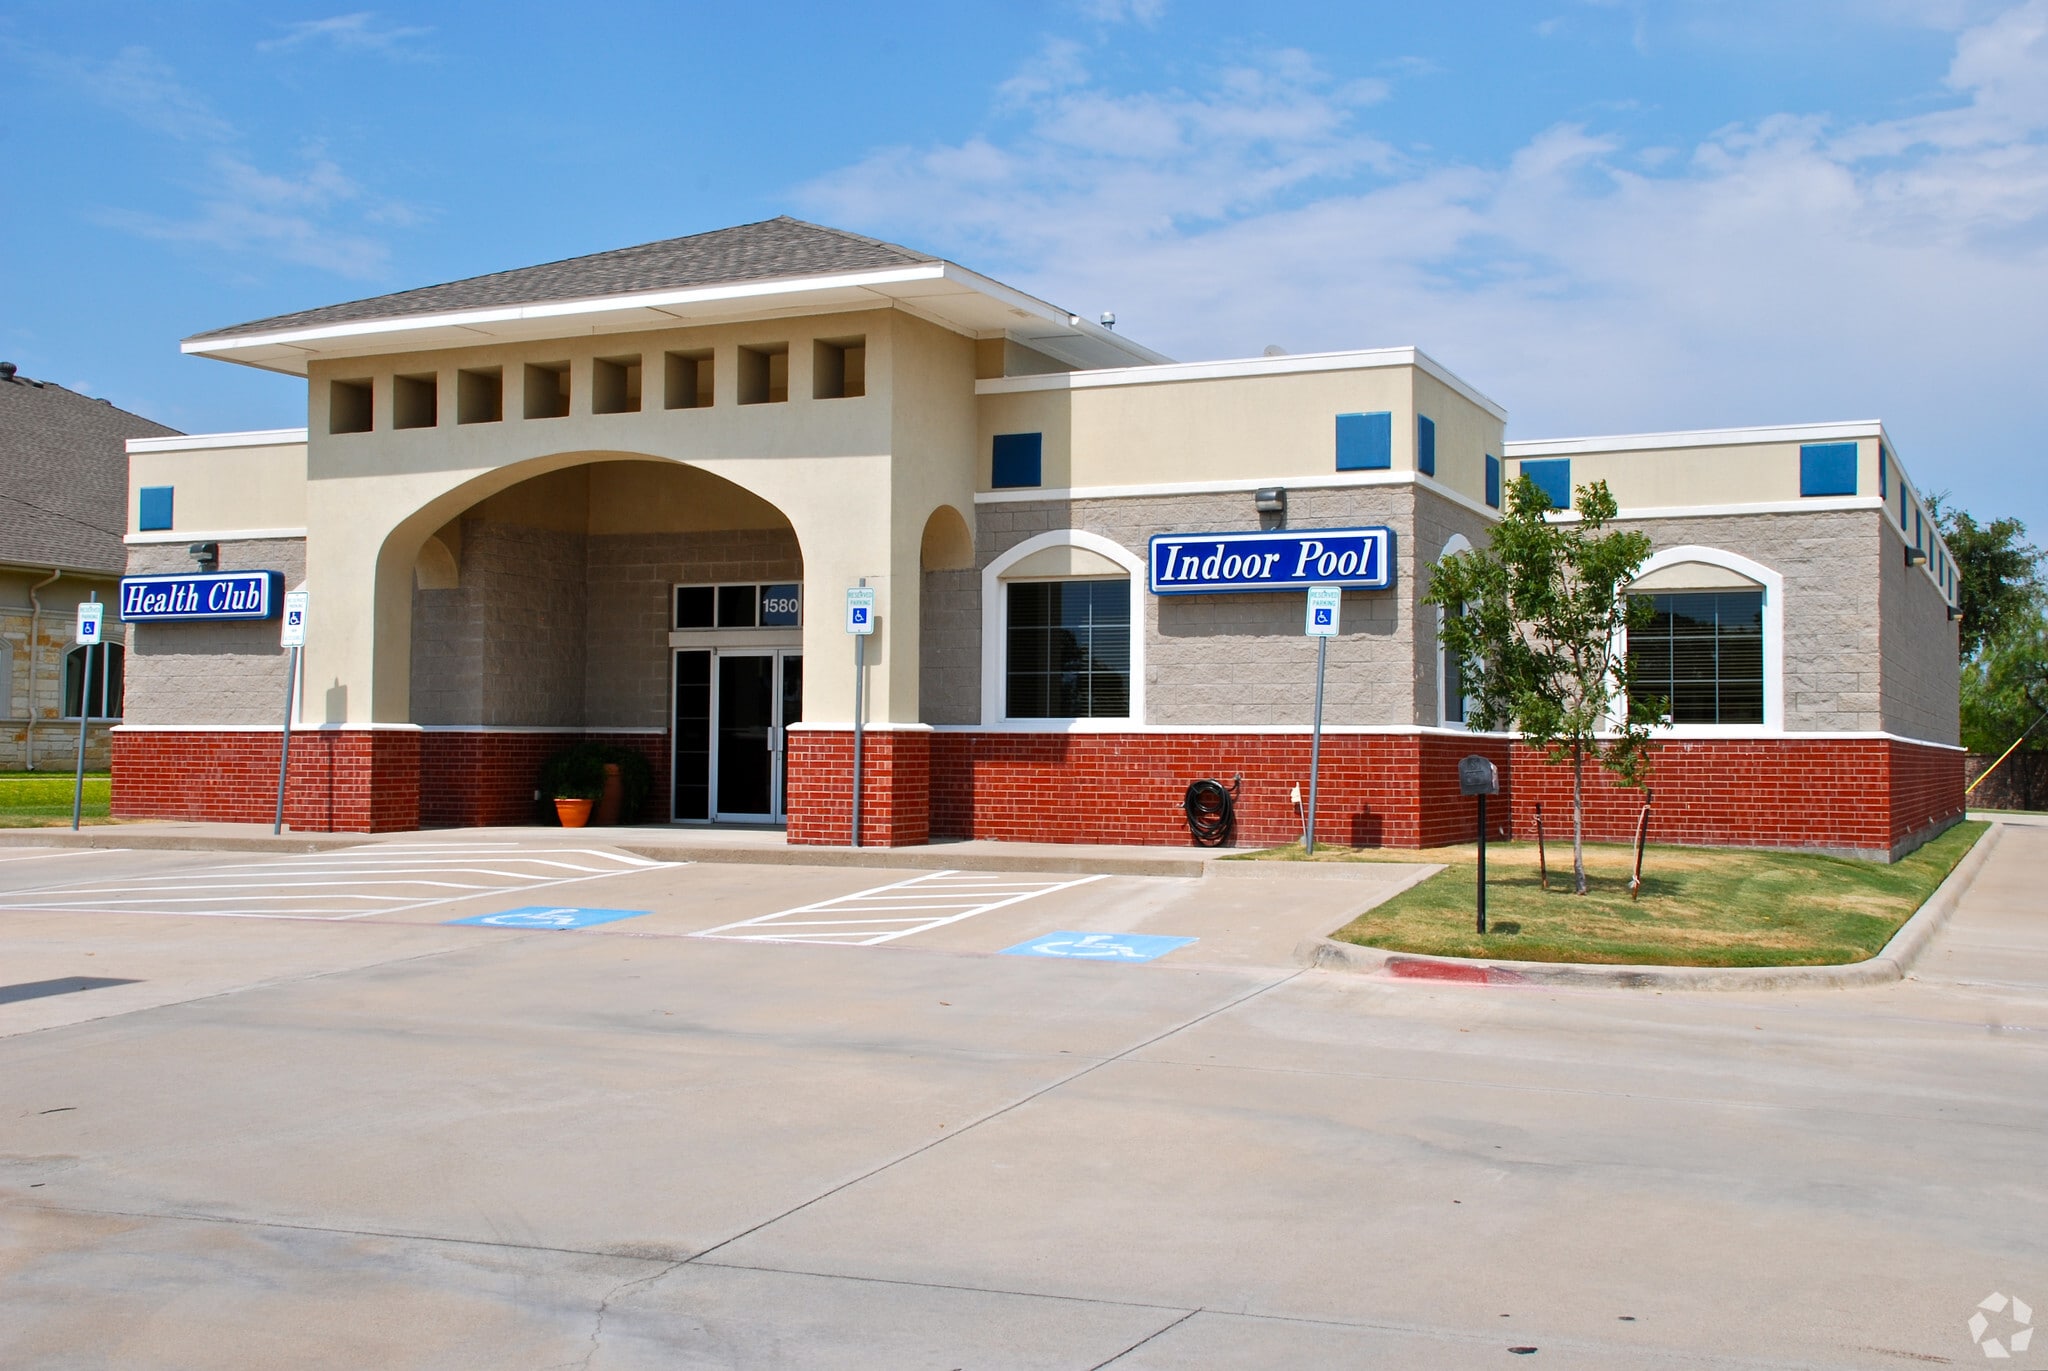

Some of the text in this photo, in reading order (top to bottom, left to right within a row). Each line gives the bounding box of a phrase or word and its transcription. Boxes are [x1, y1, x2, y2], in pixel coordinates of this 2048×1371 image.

[1160, 538, 1373, 581] Indoor Pool
[124, 581, 260, 613] Health Club
[763, 598, 798, 613] 1580
